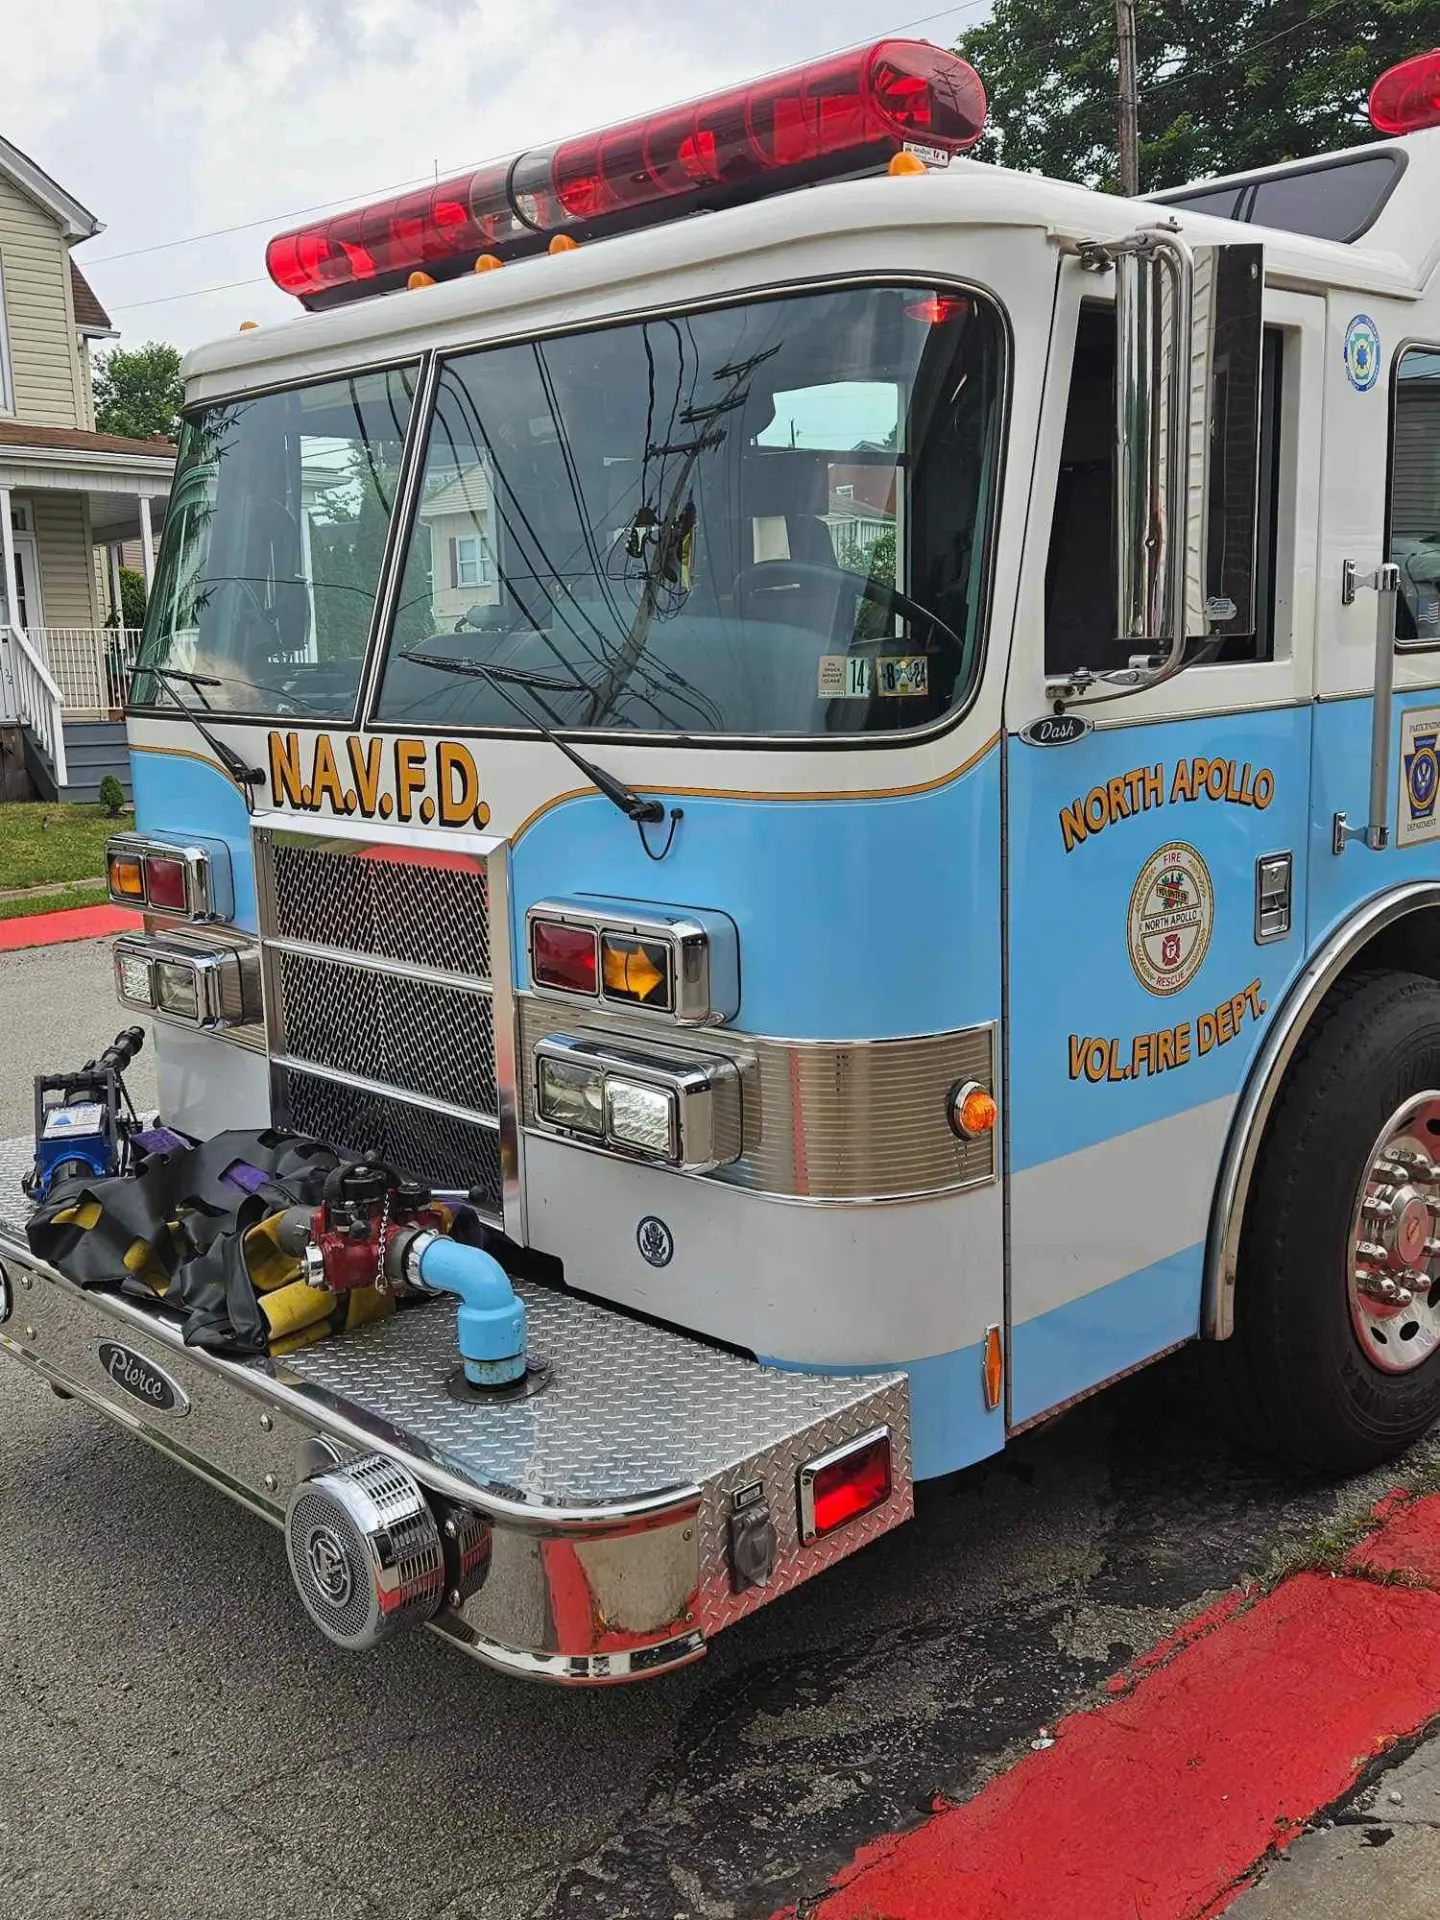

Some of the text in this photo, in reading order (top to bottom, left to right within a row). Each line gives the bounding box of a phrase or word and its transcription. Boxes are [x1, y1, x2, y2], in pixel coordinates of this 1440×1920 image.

[851, 659, 865, 694] 14
[886, 662, 895, 690] 8
[1040, 719, 1074, 740] Dash
[268, 731, 491, 831] N.A.V.F.D.
[1060, 757, 1275, 853] NORTH APOLLO
[1163, 852, 1182, 866] FIRE
[1145, 910, 1198, 931] NORTH APOLLO
[1156, 972, 1185, 987] RESCUE
[1197, 977, 1267, 1057] DEPT.
[108, 1347, 164, 1401] Pierce
